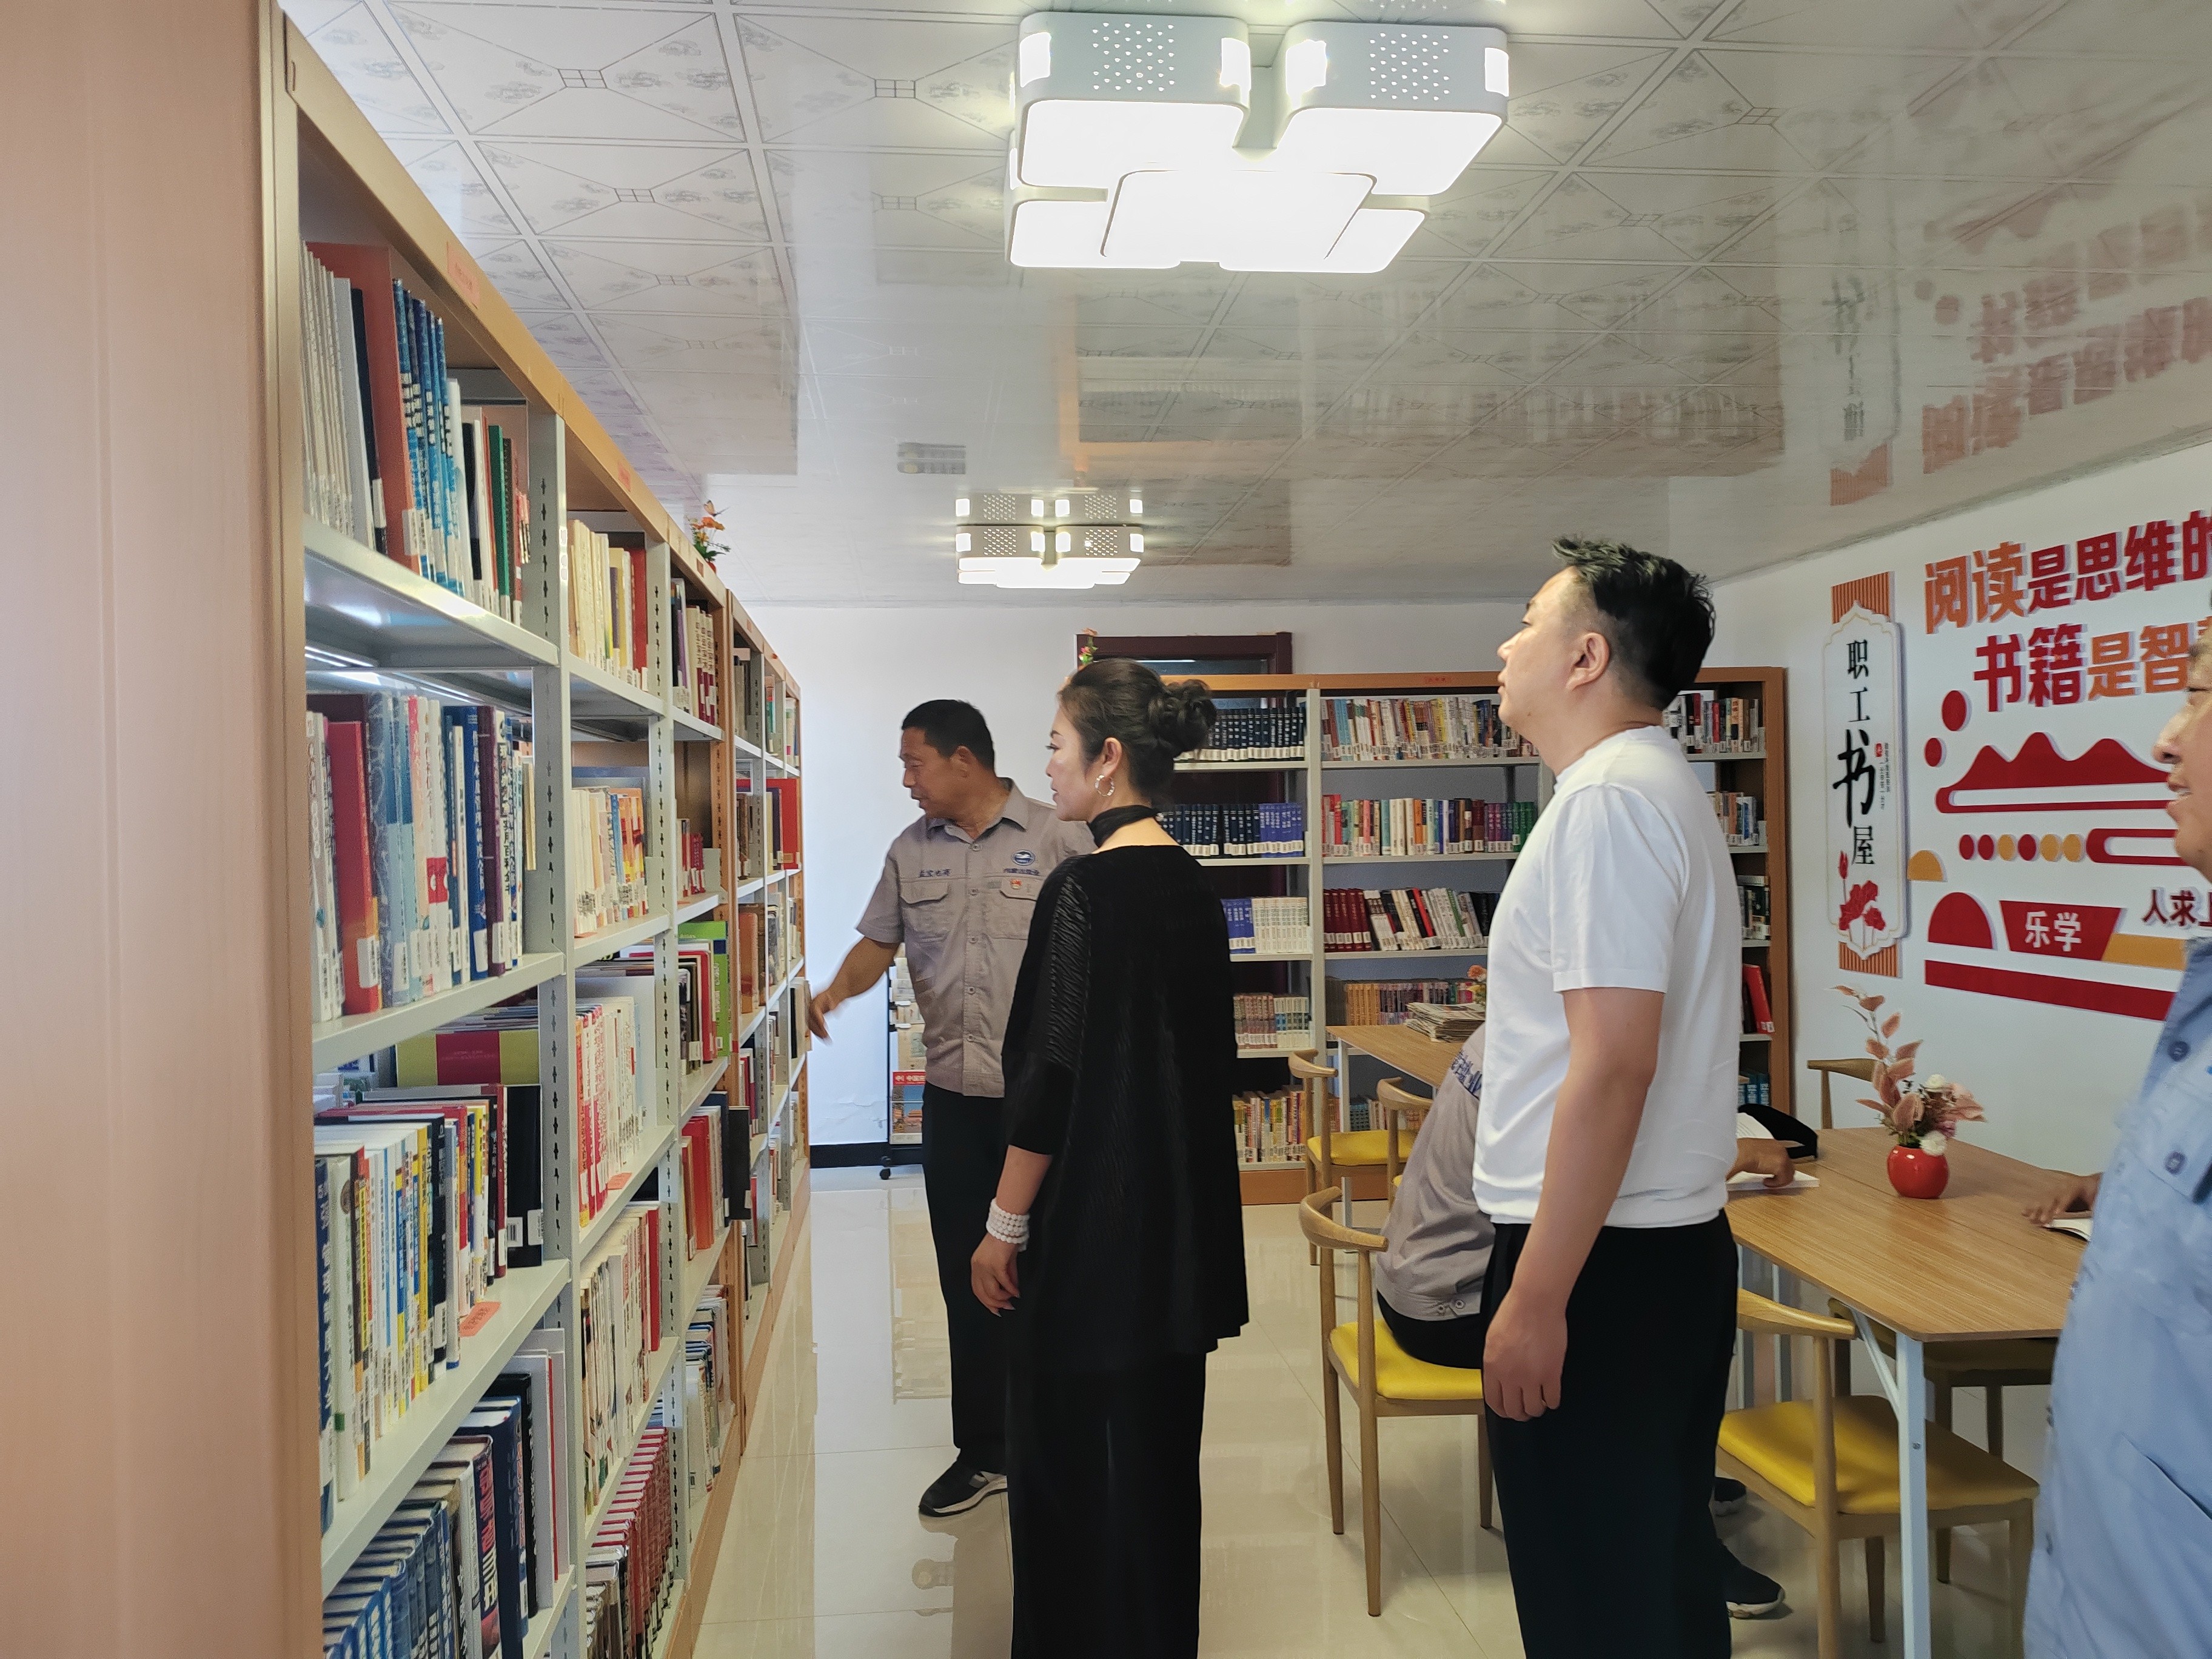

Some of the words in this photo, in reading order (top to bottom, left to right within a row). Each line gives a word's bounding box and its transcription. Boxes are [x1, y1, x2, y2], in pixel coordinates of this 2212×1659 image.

[1974, 616, 2212, 712] 书籍是智
[1832, 638, 1876, 866] 职工书屋
[2025, 911, 2082, 952] 乐学
